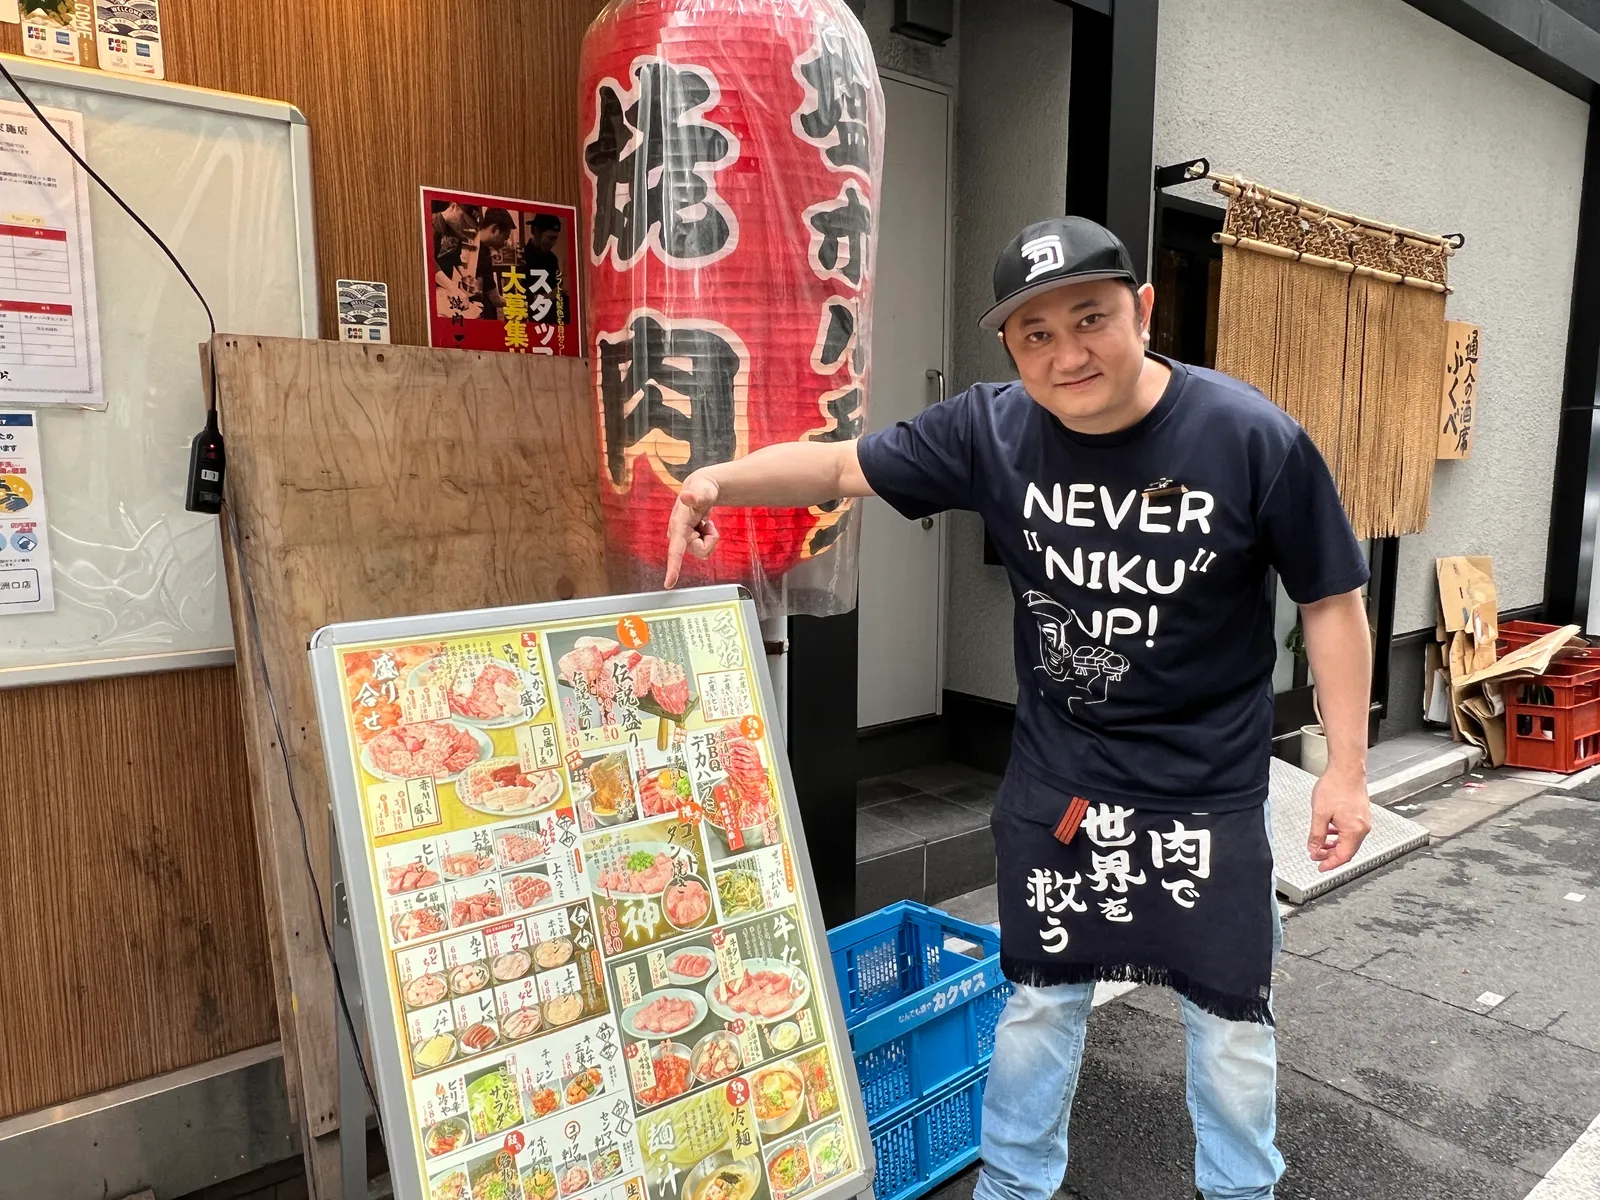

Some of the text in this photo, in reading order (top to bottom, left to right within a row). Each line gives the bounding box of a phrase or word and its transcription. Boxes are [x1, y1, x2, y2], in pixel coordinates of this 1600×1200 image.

[585, 58, 748, 492] 焼肉
[1442, 340, 1464, 436] ふくべ
[1023, 481, 1215, 534] NEVER
[1070, 604, 1159, 648] UP!
[371, 652, 400, 704] 盛り
[525, 648, 546, 706] ここから
[353, 682, 383, 731] 合せ
[519, 691, 536, 720] 盛り
[612, 662, 642, 748] 伝説盛り
[542, 726, 554, 758] 白盛り
[704, 732, 722, 772] BBQ
[691, 735, 717, 814] デカハラミ
[551, 862, 565, 899] 上ハラミ
[1080, 802, 1147, 922] 世界を
[1147, 819, 1211, 909] 肉で
[621, 898, 661, 942] 神
[1025, 867, 1088, 953] 救う
[932, 971, 986, 1013] カクヤス
[583, 1034, 596, 1064] キムチ
[488, 1085, 506, 1130] サラダ
